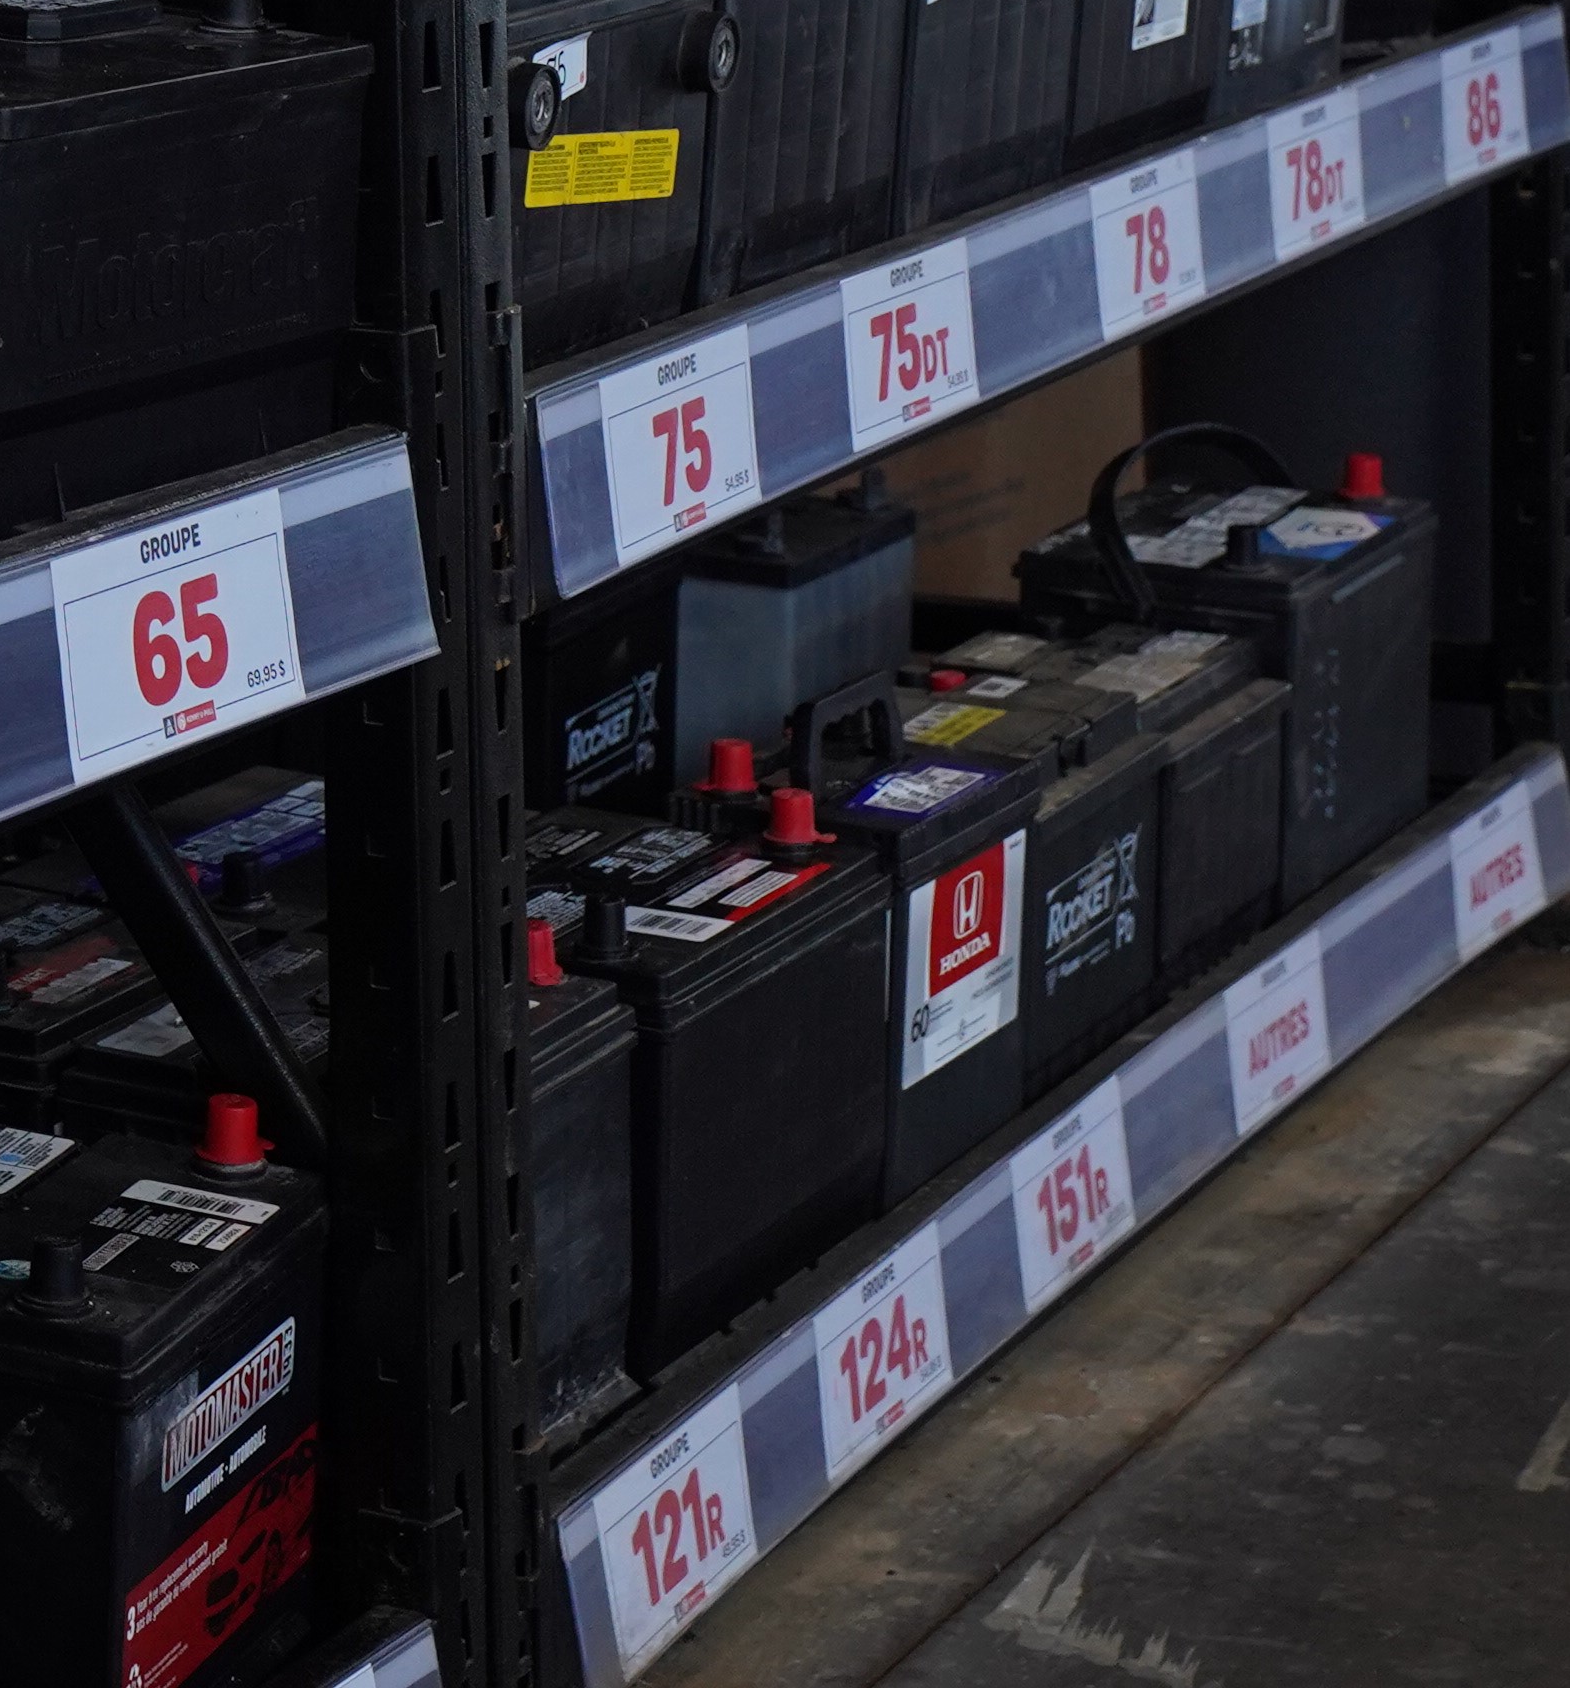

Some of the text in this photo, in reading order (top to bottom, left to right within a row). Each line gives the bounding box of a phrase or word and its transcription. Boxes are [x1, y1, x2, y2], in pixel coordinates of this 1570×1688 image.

[1467, 72, 1501, 146] 86
[1286, 140, 1345, 222] 78DT
[890, 259, 924, 288] GROUPE
[1125, 206, 1170, 295] 78
[657, 352, 697, 386] GROUPE
[870, 302, 950, 403] 75DT
[652, 396, 712, 507] 75
[140, 523, 201, 564] GROUPE
[133, 572, 229, 707] 65
[247, 660, 286, 688] 69,95 $
[939, 932, 991, 976] HONDA
[1248, 1001, 1310, 1079] AUTRES
[1037, 1143, 1109, 1257] 151R
[839, 1294, 928, 1424] 124R
[171, 1338, 283, 1481] MOTOMASTER
[650, 1430, 690, 1480] GROUPE
[631, 1467, 726, 1607] 121R
[126, 1606, 136, 1641] 3
